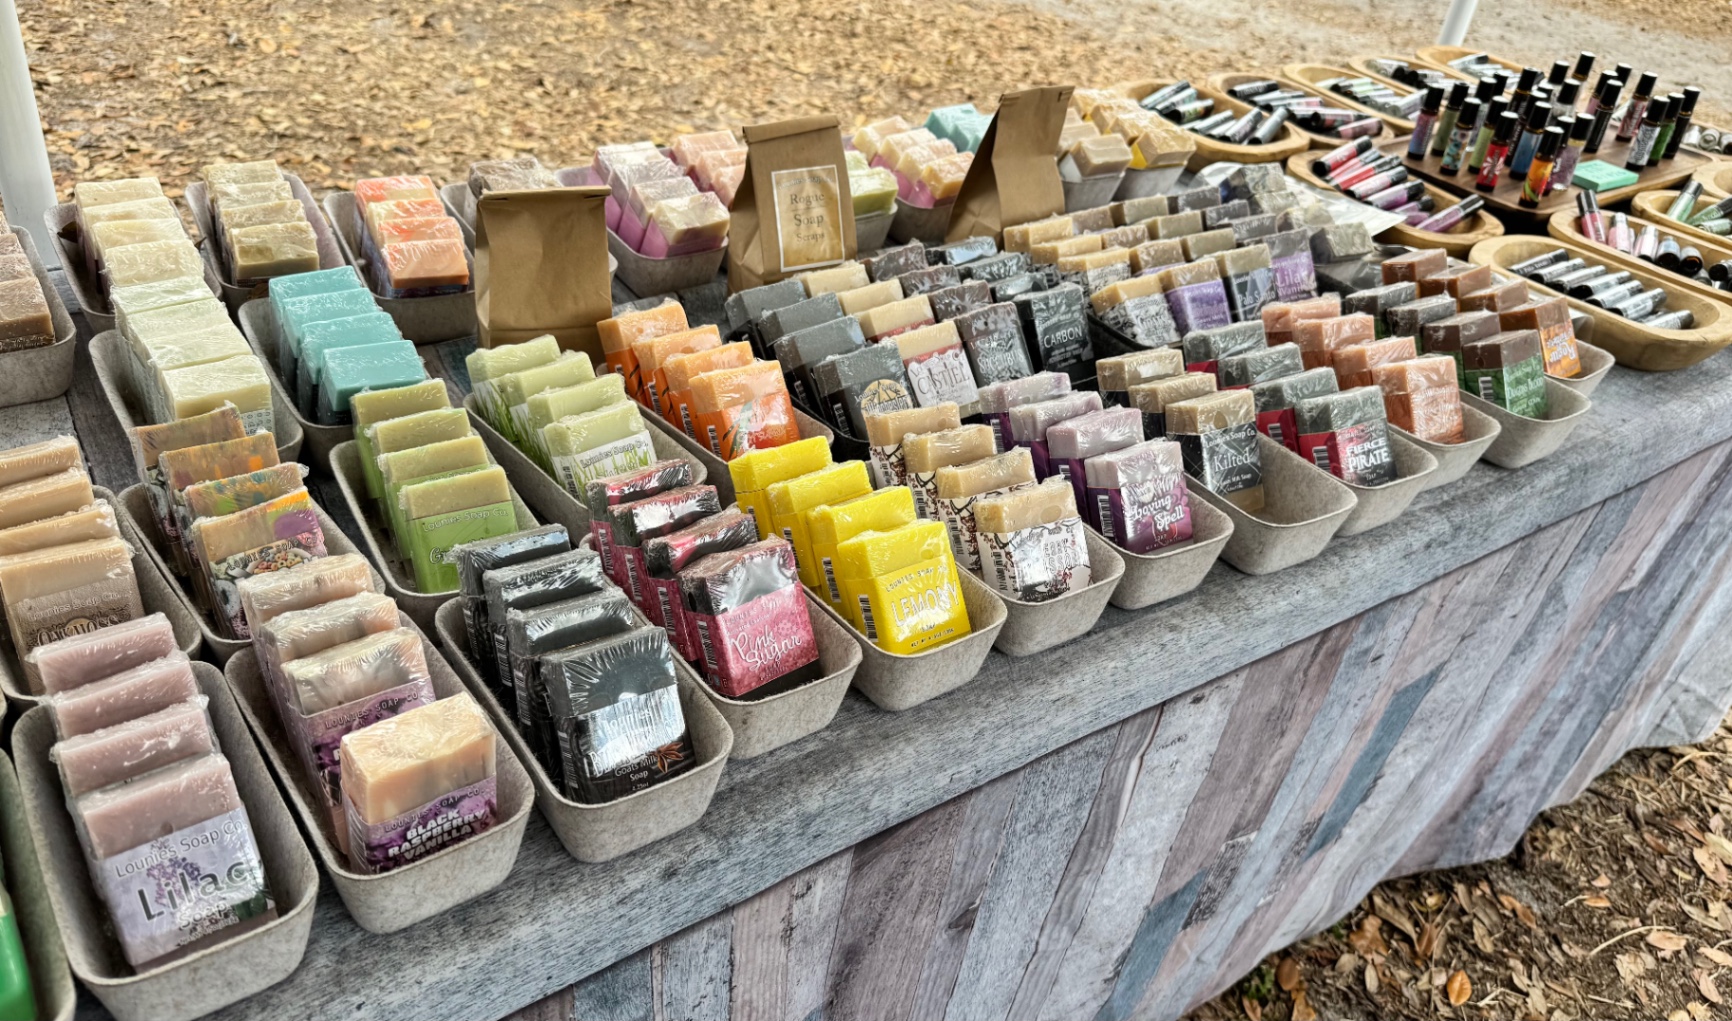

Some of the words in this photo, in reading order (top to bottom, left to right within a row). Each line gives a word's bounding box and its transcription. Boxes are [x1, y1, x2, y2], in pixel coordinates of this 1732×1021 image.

[789, 192, 826, 207] Rogue
[792, 212, 825, 228] Soap
[795, 231, 826, 243] Scraps
[1043, 325, 1083, 349] CARBON
[917, 360, 970, 395] CASTIEL
[613, 442, 635, 456] Soap
[1230, 431, 1245, 440] Soap
[1346, 437, 1387, 456] FIERCE
[1213, 446, 1251, 472] Kilted
[1348, 447, 1391, 473] PIRATE
[422, 515, 462, 532] Lounies
[464, 509, 490, 521] Soap
[1130, 494, 1172, 521] Loving
[1154, 504, 1185, 531] Spell
[890, 580, 960, 628] LEMONY
[729, 625, 776, 661] Pink
[745, 634, 802, 672] Sugar
[325, 709, 369, 730] LOUNIES
[375, 697, 399, 713] SOAP
[614, 762, 639, 777] Goats
[629, 770, 649, 782] Soap
[388, 809, 486, 858] RASPBERRY
[406, 809, 461, 840] BLACK
[115, 846, 178, 878] Lounies
[179, 828, 221, 852] Soap
[403, 824, 473, 860] VANILLA
[137, 860, 251, 922] Lilac
[179, 901, 228, 930] Soap
